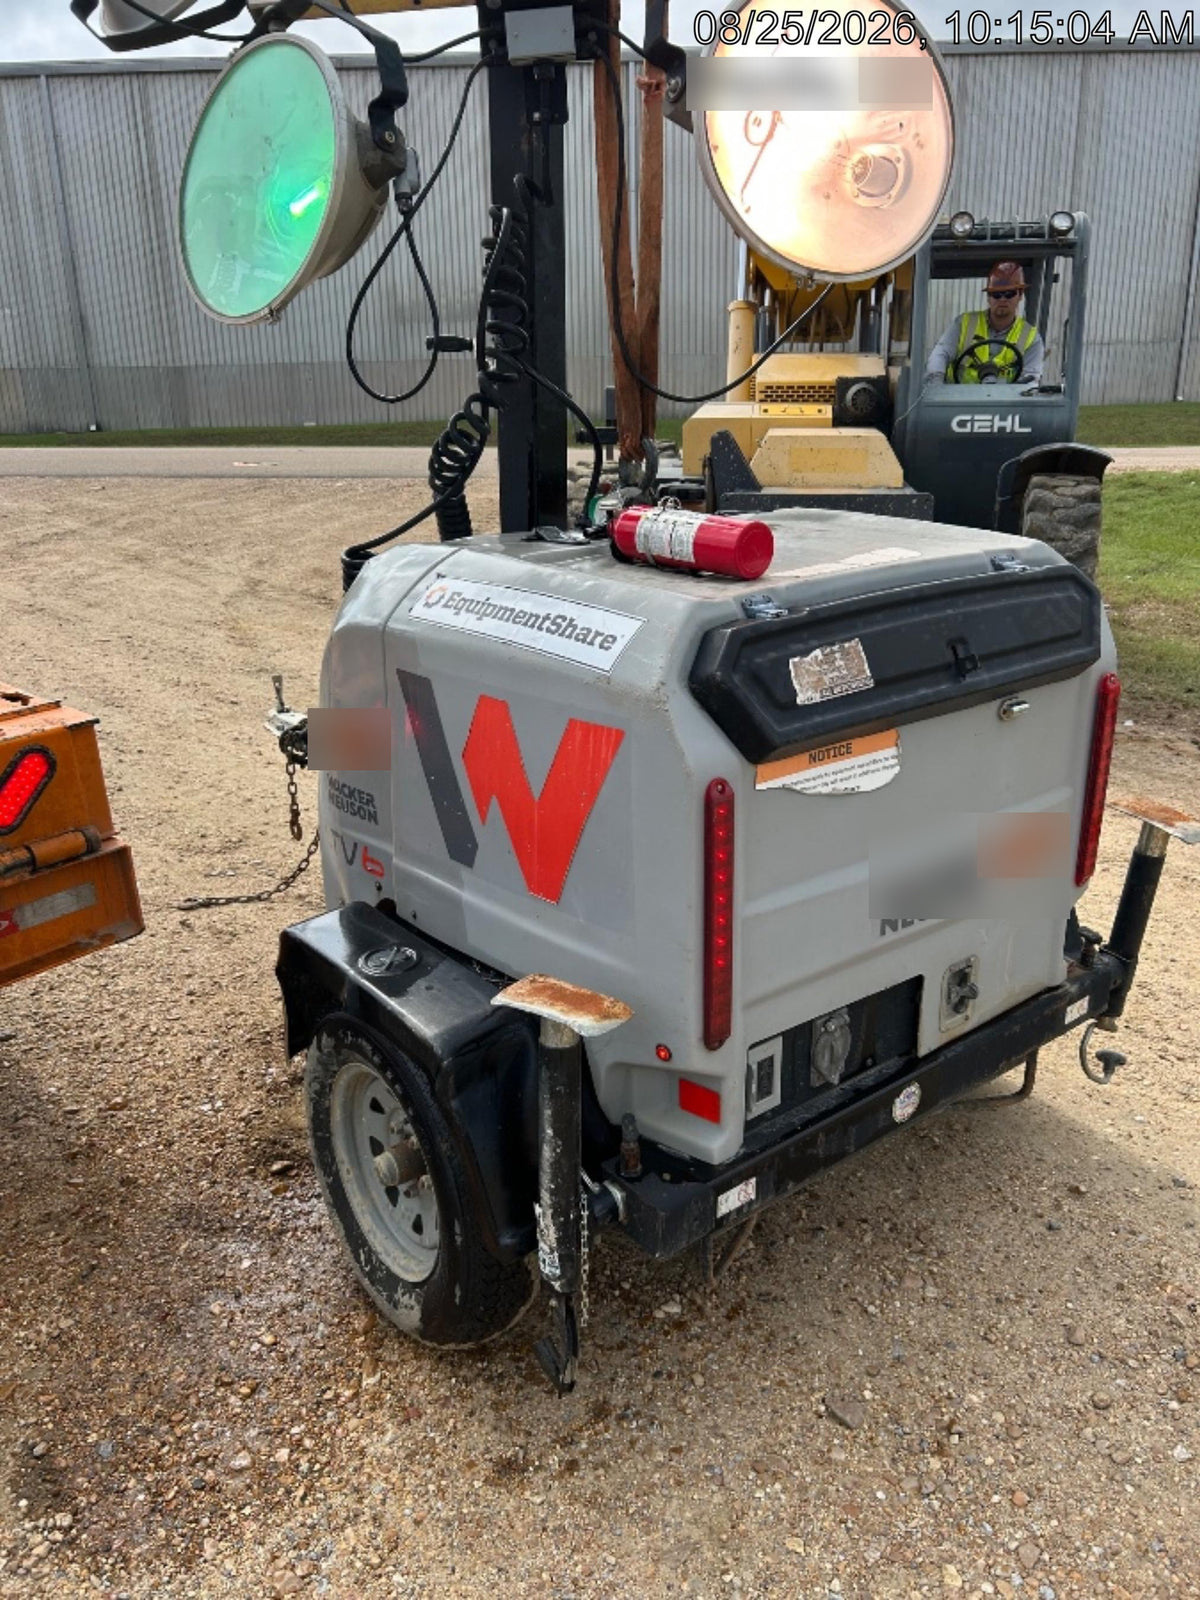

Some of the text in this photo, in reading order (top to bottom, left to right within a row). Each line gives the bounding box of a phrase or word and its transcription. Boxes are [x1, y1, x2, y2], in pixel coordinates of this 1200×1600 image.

[950, 413, 1032, 433] GEHL
[441, 590, 618, 652] EquipmentShare
[808, 742, 853, 765] NOTICE
